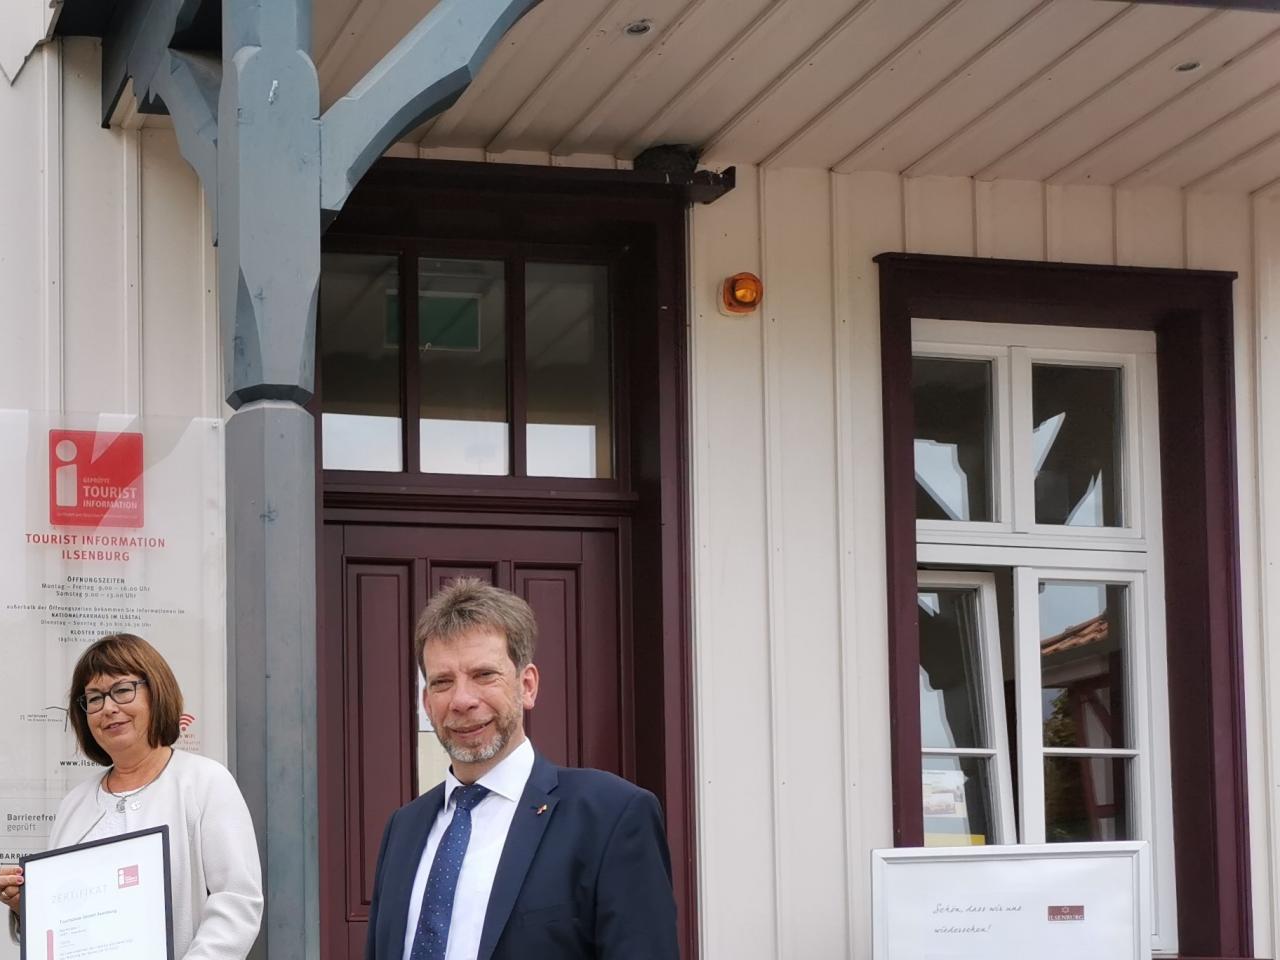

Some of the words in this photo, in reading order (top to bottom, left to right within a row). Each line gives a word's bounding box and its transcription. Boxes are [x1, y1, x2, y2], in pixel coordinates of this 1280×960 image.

[83, 486, 137, 499] TOURIST
[83, 500, 137, 509] INFORMATION
[25, 533, 78, 545] TOURIST
[82, 535, 165, 548] INFORMATION
[62, 550, 130, 562] ILSENBURG
[67, 575, 125, 584] ÖFFNUNGSZEITEN
[56, 590, 83, 598] Samstag
[7, 813, 57, 822] Barrierefrei
[7, 823, 36, 832] geprüft
[966, 905, 987, 913] dass
